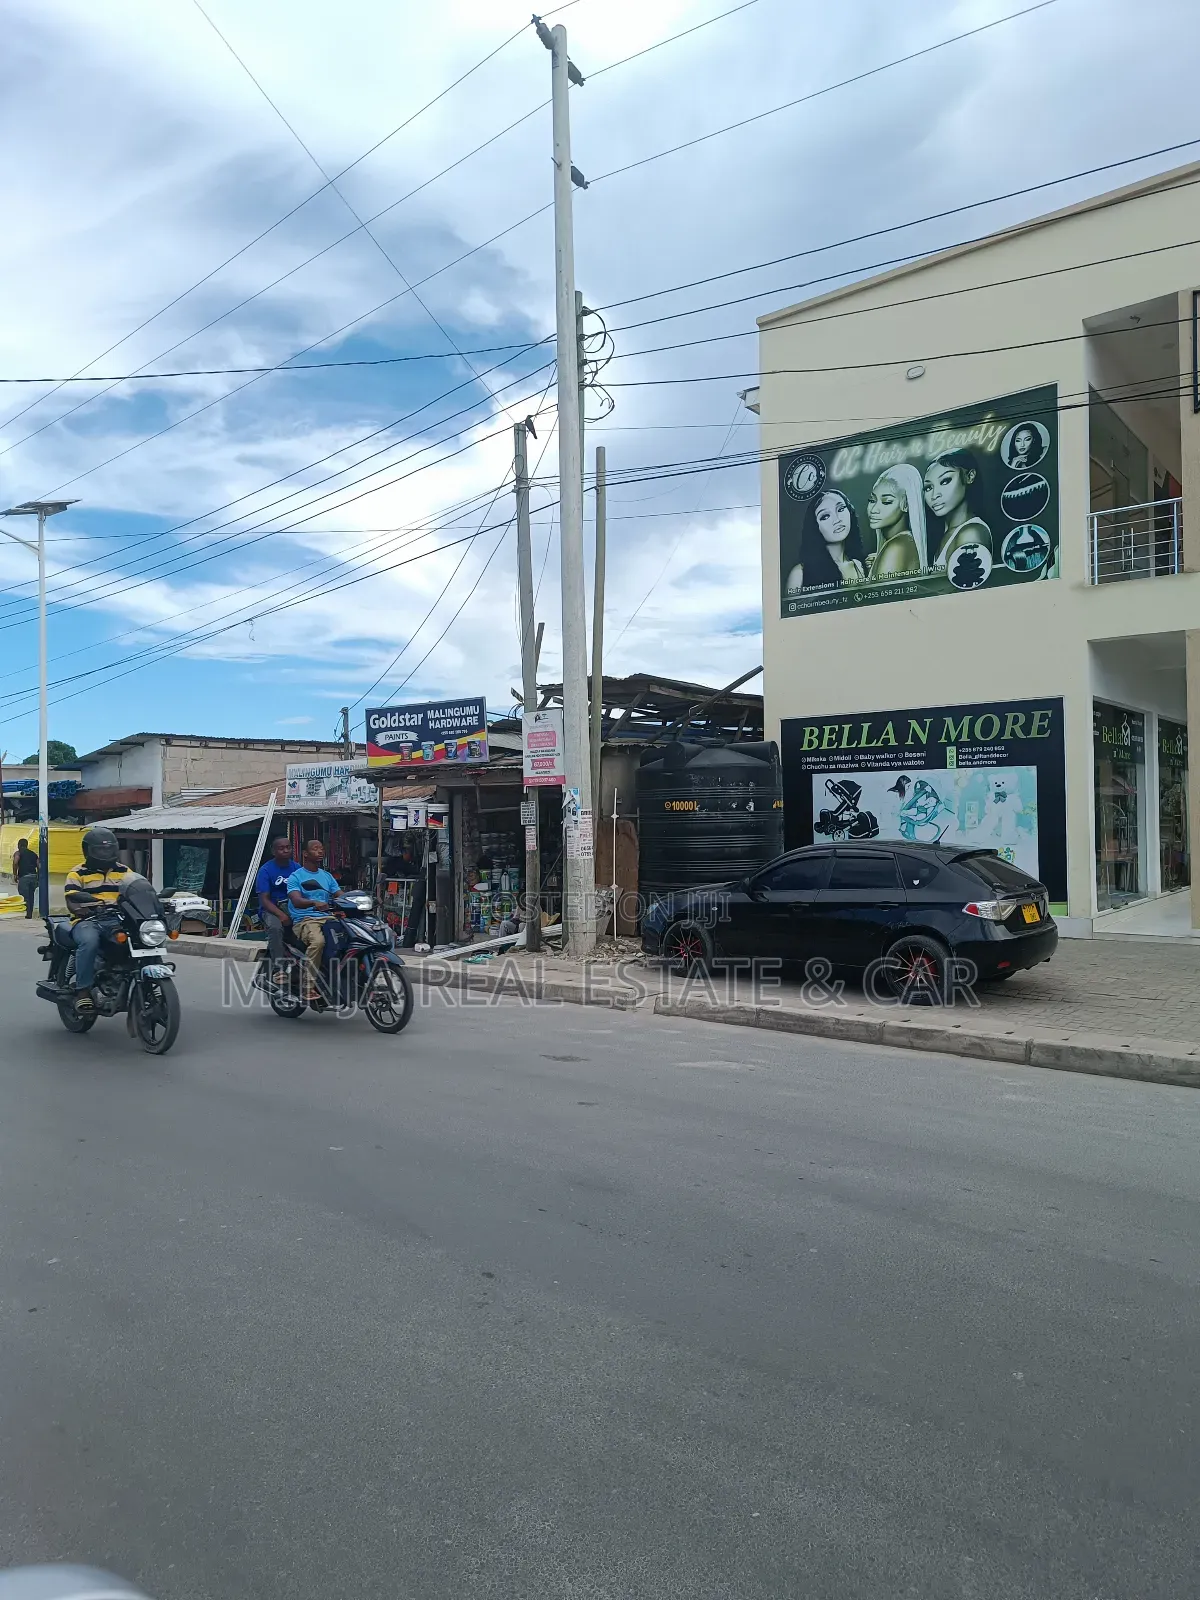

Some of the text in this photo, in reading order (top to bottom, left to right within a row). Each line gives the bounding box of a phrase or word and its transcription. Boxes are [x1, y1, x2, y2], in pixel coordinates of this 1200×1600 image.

[865, 440, 908, 474] Hair
[926, 414, 1007, 462] Beauty
[787, 587, 802, 595] Hair
[802, 581, 835, 592] Extensions
[840, 578, 855, 586] Hair
[878, 568, 922, 580] Maintenance
[927, 564, 946, 573] Wigs
[863, 591, 879, 600] +255
[427, 705, 480, 719] MALINGUMU
[369, 712, 424, 729] Goldstar
[429, 716, 479, 729] HARDWARE
[384, 732, 409, 741] PAINTS
[800, 710, 1053, 750] BELLA N MORE
